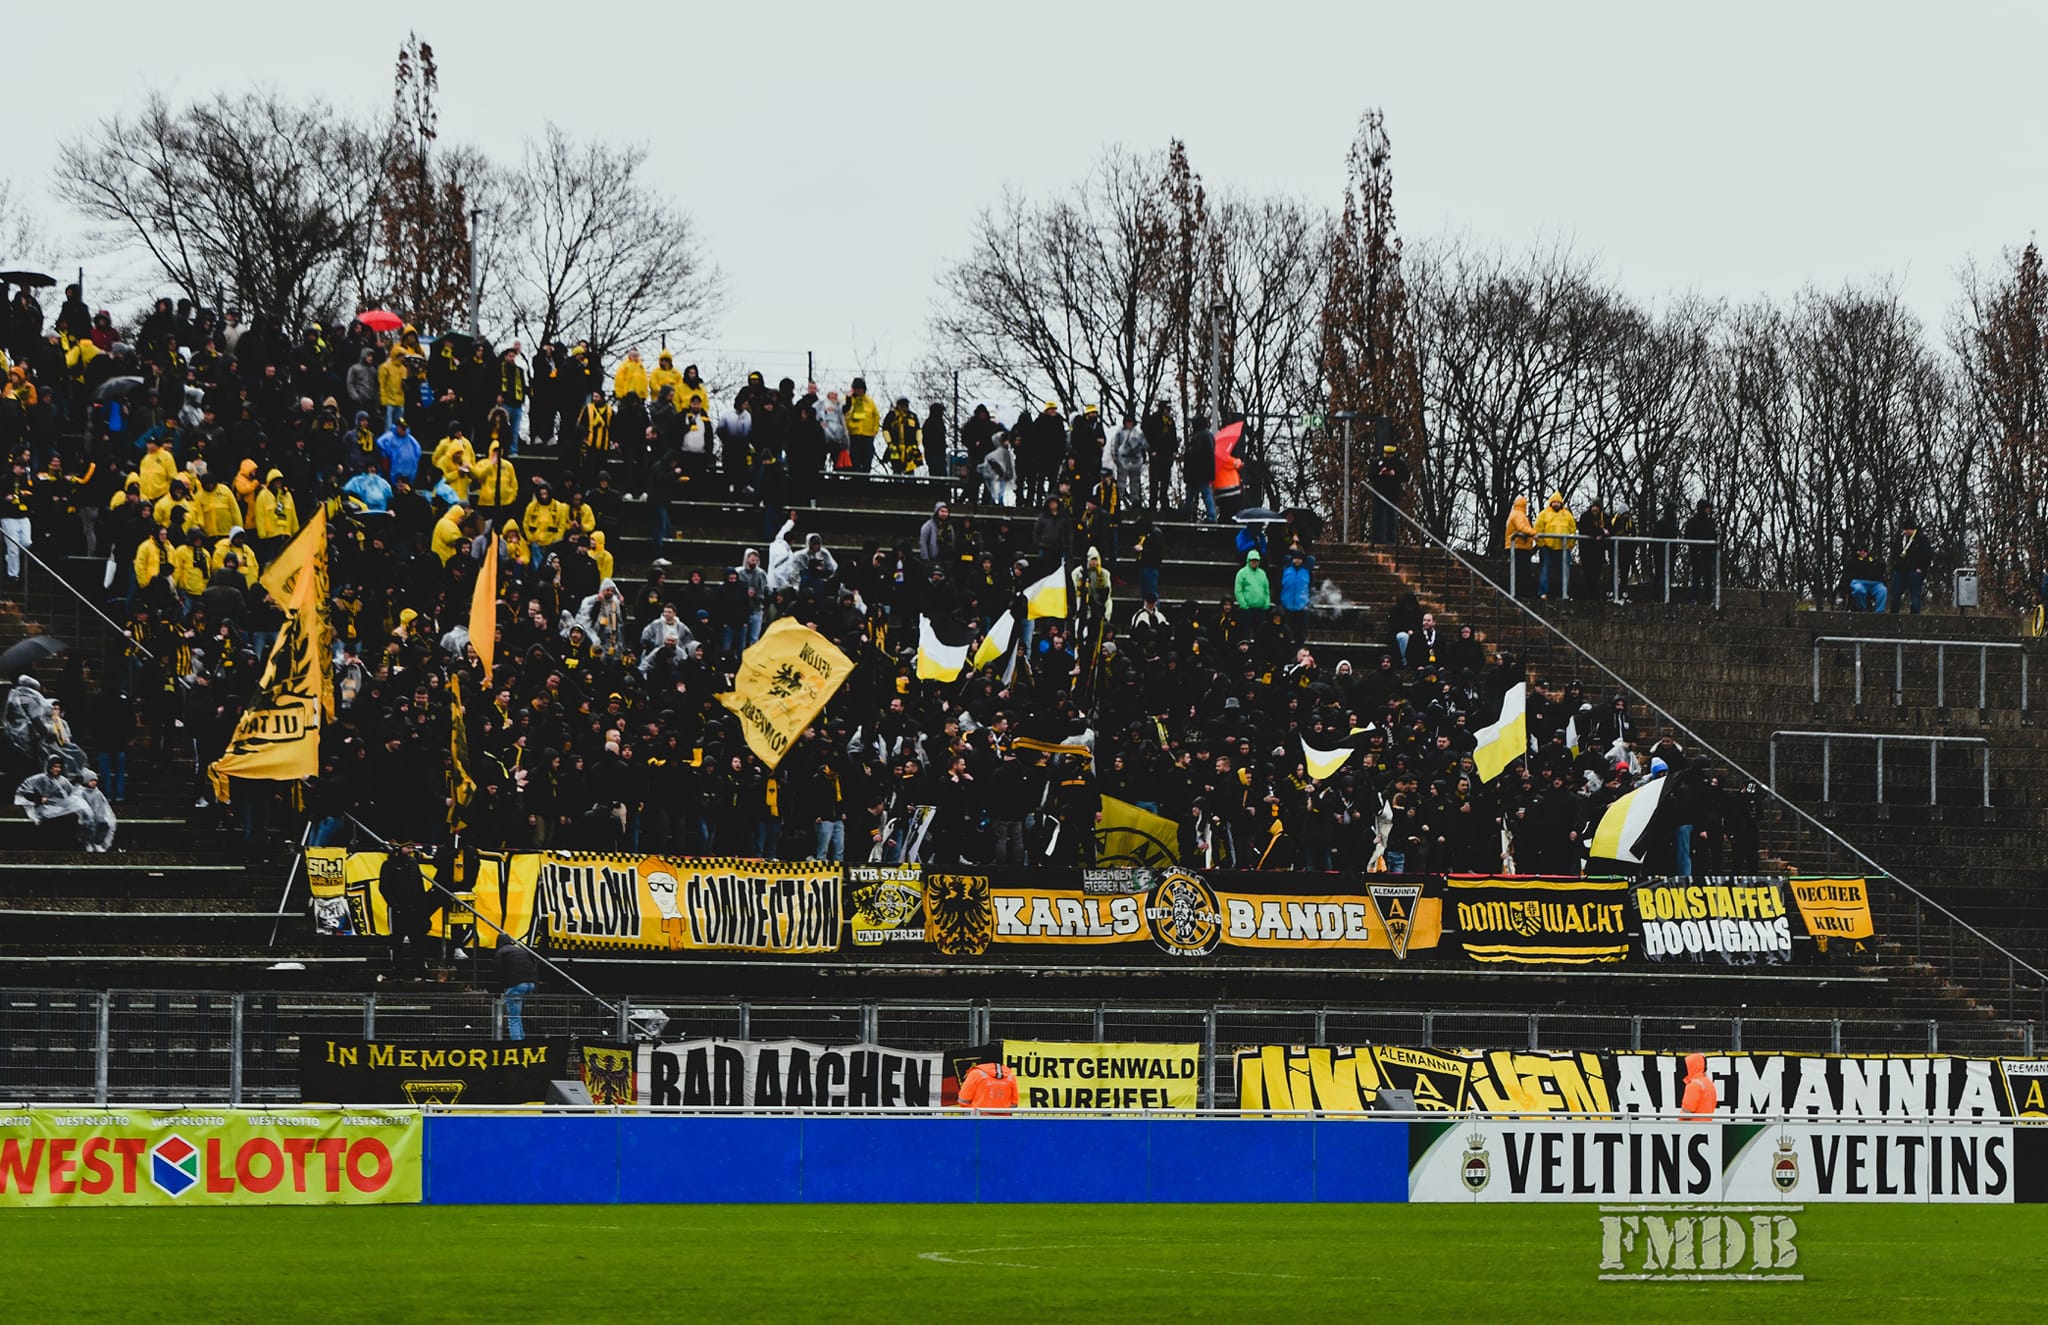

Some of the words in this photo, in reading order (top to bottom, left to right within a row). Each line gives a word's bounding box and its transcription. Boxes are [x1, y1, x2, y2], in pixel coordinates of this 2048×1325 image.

[850, 866, 879, 881] FÜR
[880, 868, 923, 881] STADT
[541, 863, 641, 938] YELLOW
[687, 874, 839, 949] CONNECTION
[1373, 888, 1417, 896] ALEMANNIA
[1636, 885, 1787, 921] BOXSTAFFEL
[1796, 886, 1862, 902] OECHER
[994, 897, 1140, 937] KARLS
[1228, 899, 1369, 940] BANDE
[1389, 898, 1406, 918] A
[1457, 901, 1514, 933] DOM
[1542, 902, 1625, 934] WACHT
[856, 930, 883, 942] UND
[1642, 916, 1792, 956] HOOLIGANS
[367, 1042, 549, 1071] MEMORIAM
[1006, 1051, 1196, 1080] HÜRTGENWALD
[1379, 1046, 1461, 1074] ALEMANNIA
[2007, 1063, 2048, 1074] ALEMAN
[754, 1047, 931, 1112] AACHEN
[1413, 1072, 1443, 1100] A
[1616, 1055, 2001, 1118] ALEMANNIA
[2024, 1079, 2046, 1109] A
[0, 1137, 148, 1195] WEST
[206, 1136, 393, 1194] LOTTO
[1502, 1132, 1712, 1195] VELTINS
[1810, 1134, 2008, 1196] VELTINS
